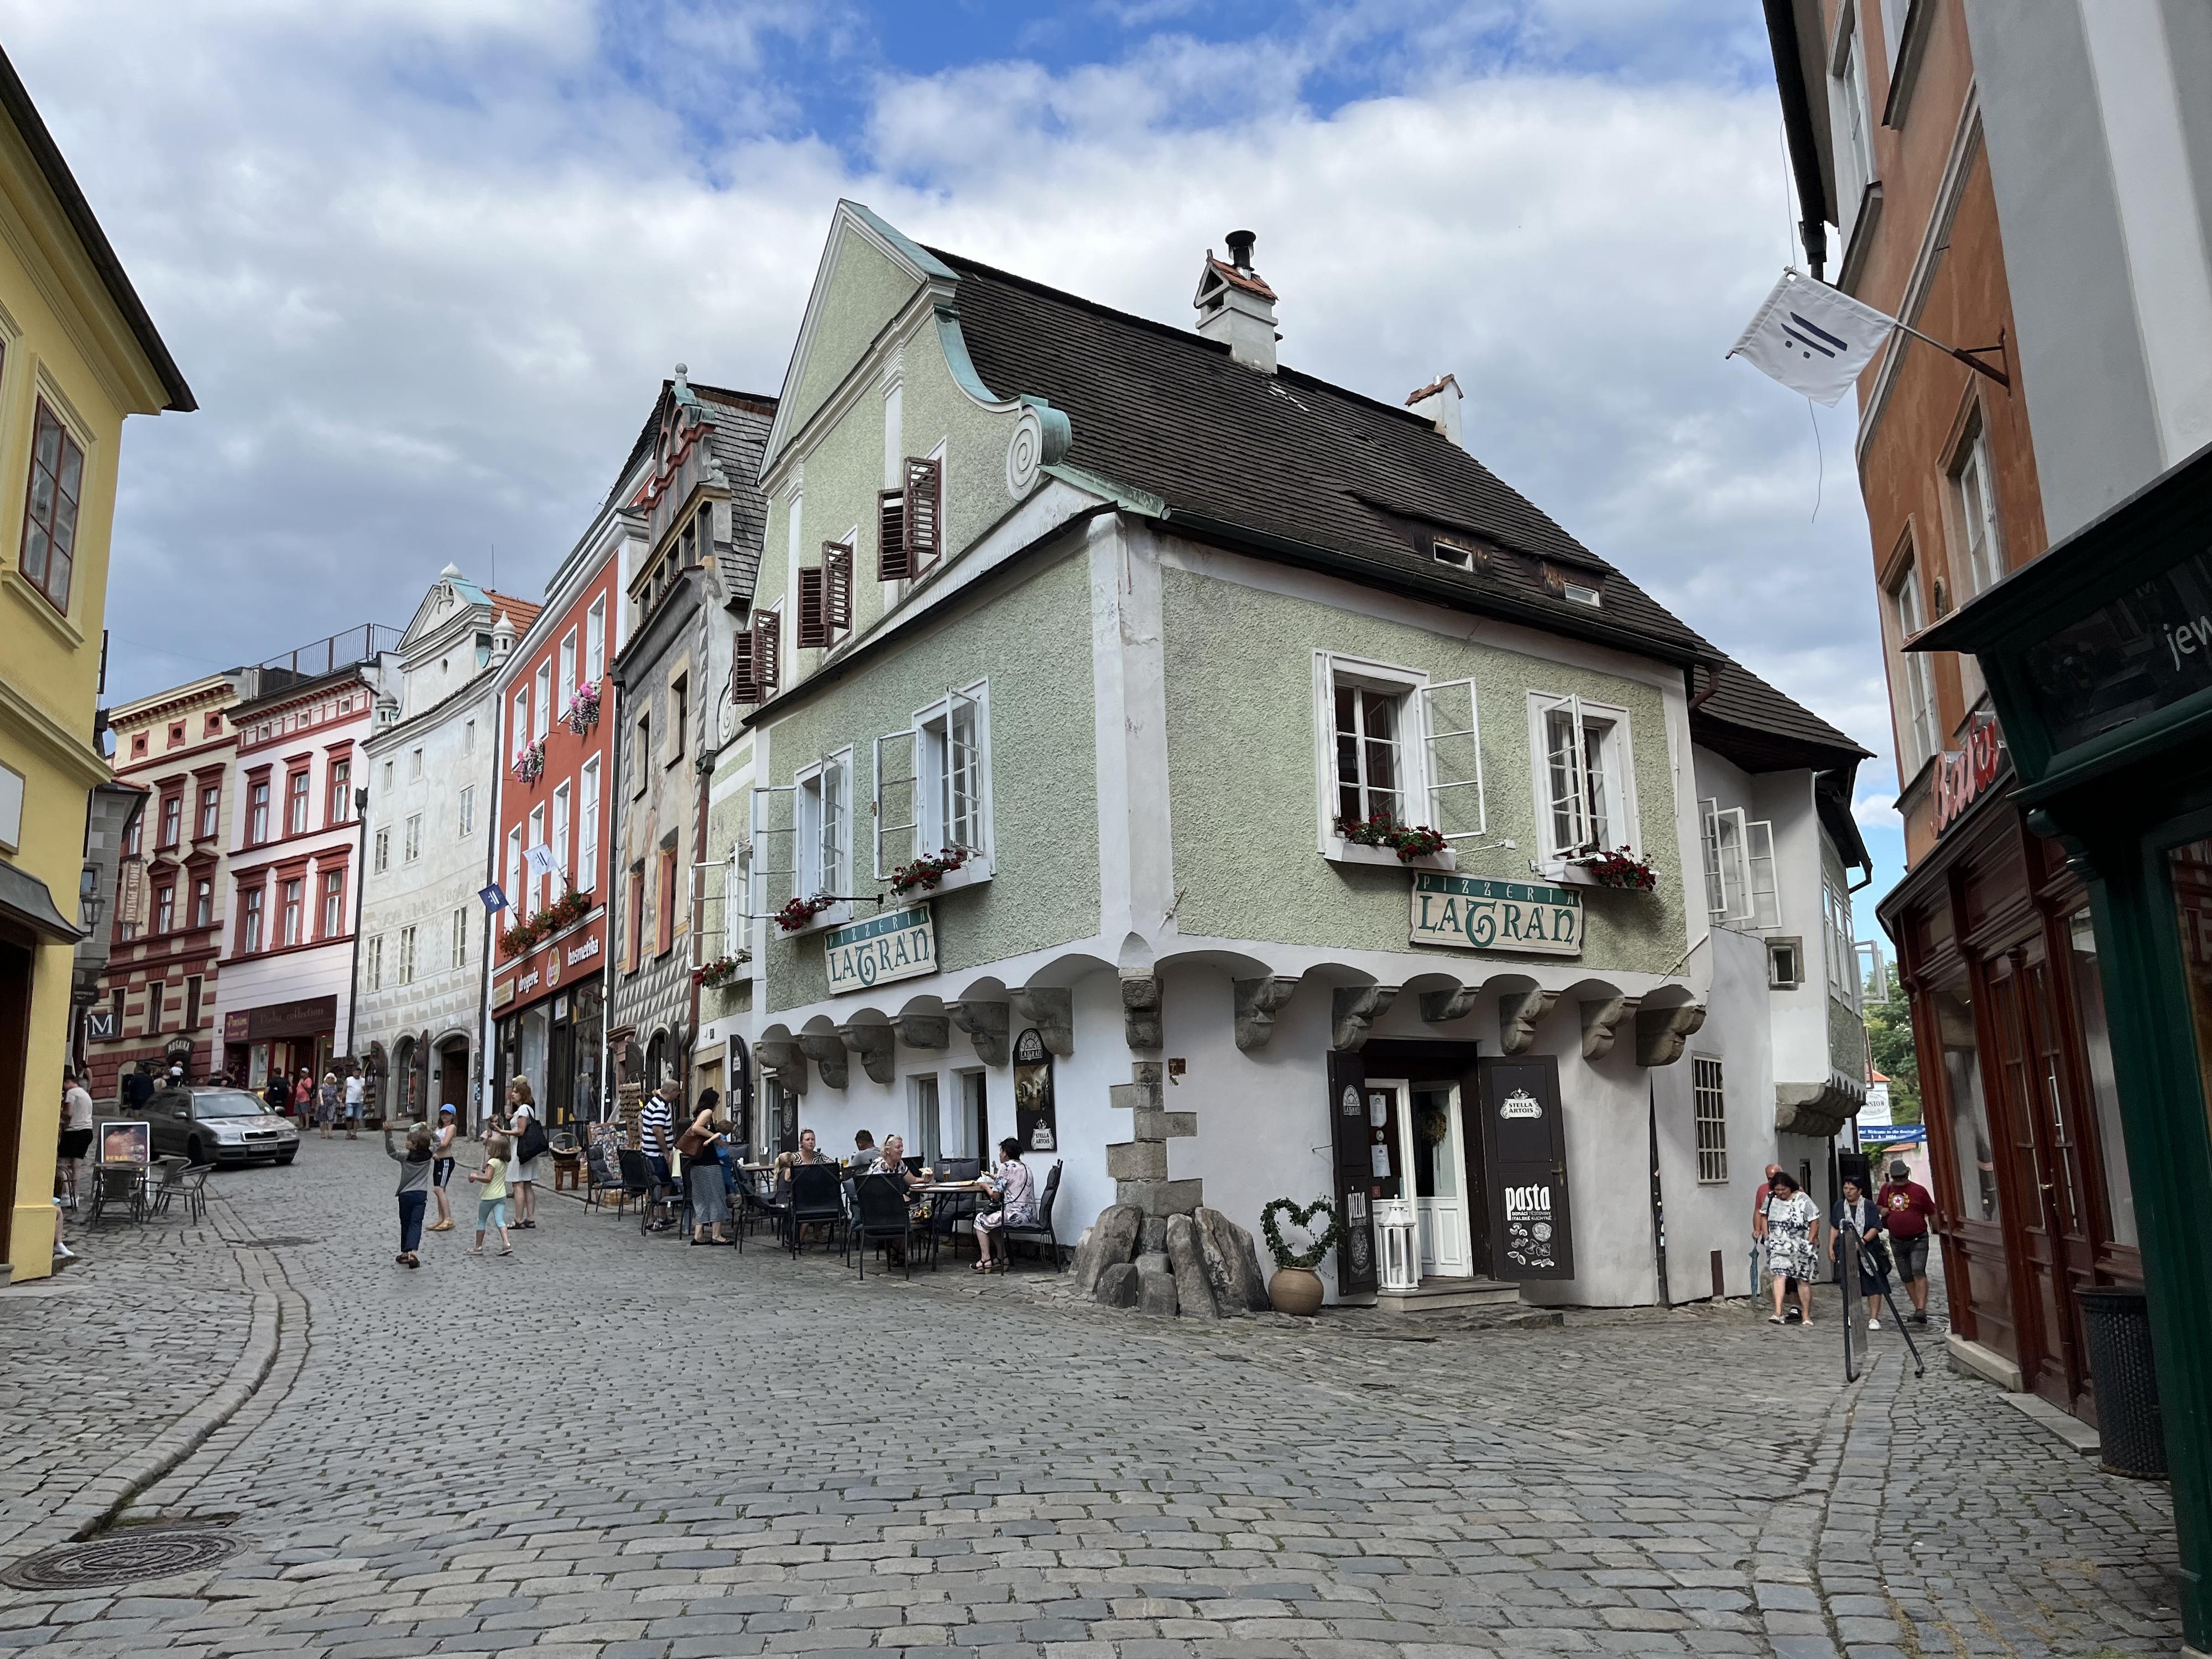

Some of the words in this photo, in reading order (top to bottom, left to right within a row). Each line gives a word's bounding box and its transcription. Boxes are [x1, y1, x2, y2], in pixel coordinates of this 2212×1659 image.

[128, 863, 140, 887] STORE
[1424, 875, 1574, 905] PIZZERIA
[125, 890, 138, 921] VINTAGE
[1418, 895, 1575, 948] LATRÁN
[830, 907, 925, 947] PIZZERIA
[568, 934, 599, 967] kosmetika
[829, 927, 930, 987] LATRÁN
[518, 966, 539, 994] drogerie
[90, 1014, 113, 1035] M
[1348, 1185, 1366, 1228] pizza
[1505, 1183, 1551, 1221] pasta
